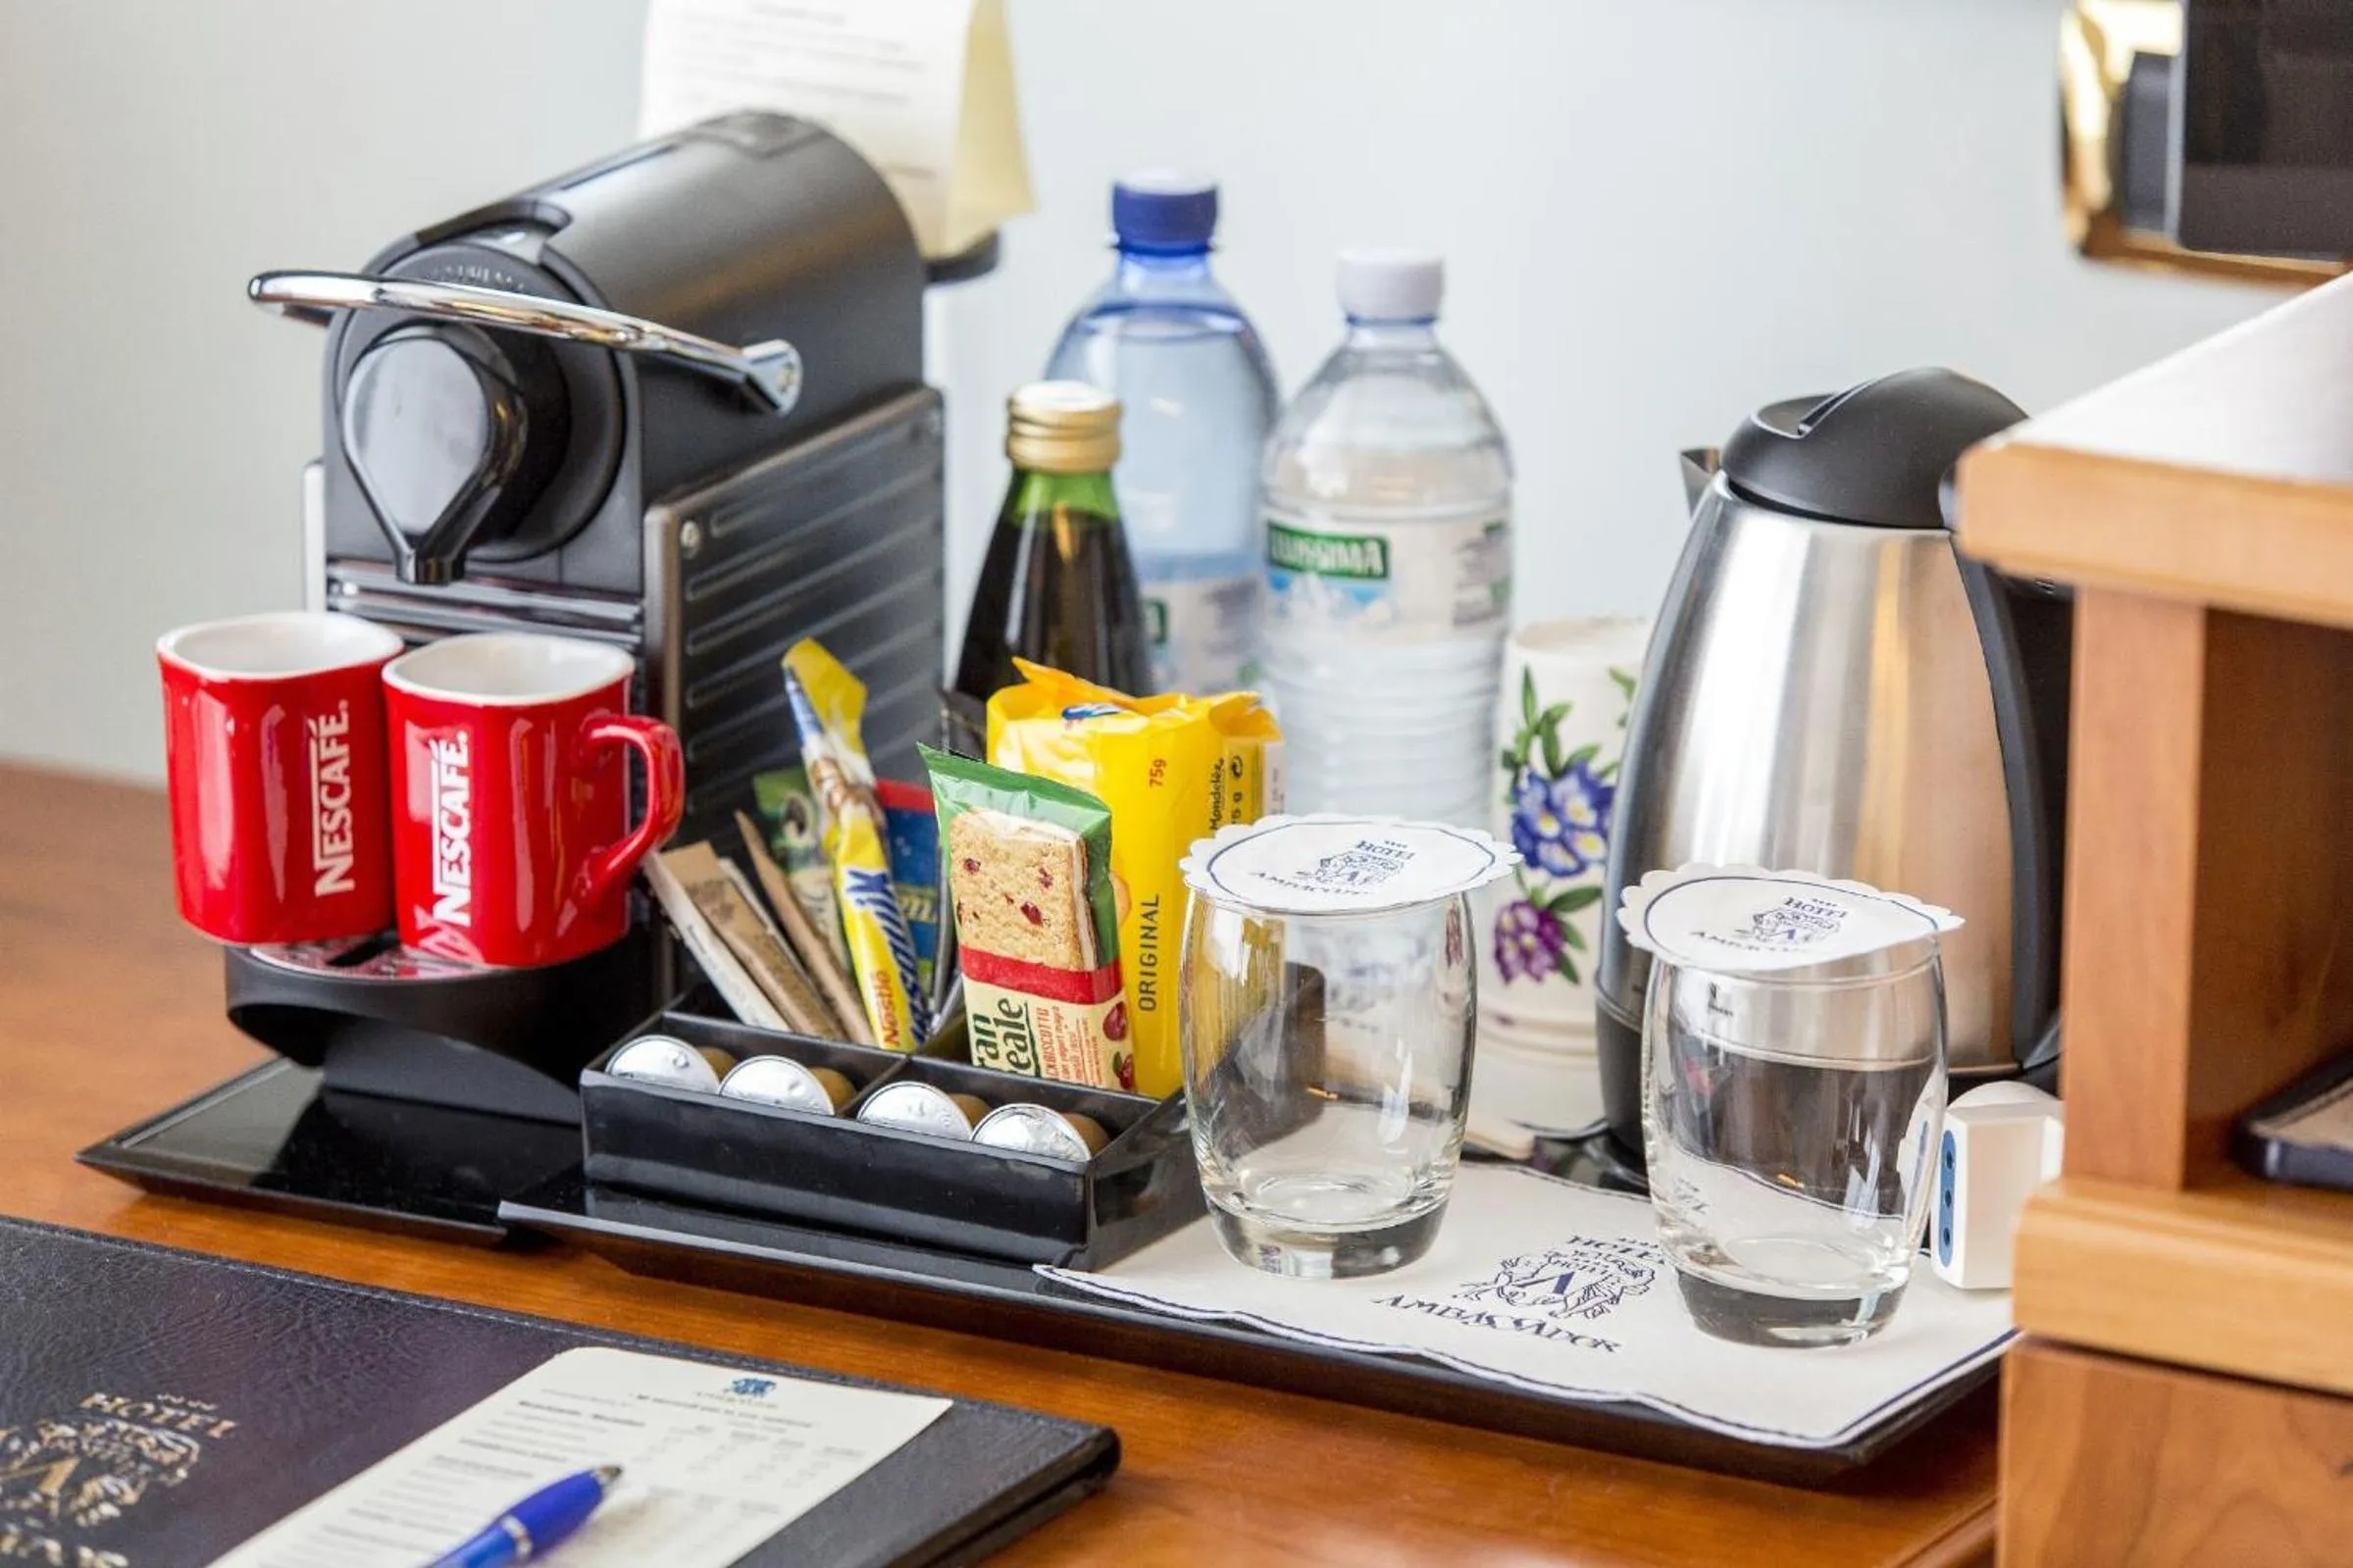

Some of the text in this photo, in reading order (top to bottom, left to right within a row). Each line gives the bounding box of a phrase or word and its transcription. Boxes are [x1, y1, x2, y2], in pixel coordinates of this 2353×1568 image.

[1149, 759, 1166, 787] 75g
[1138, 893, 1160, 1012] ORIGINAL
[972, 1013, 999, 1067] an
[993, 998, 1032, 1071] eale
